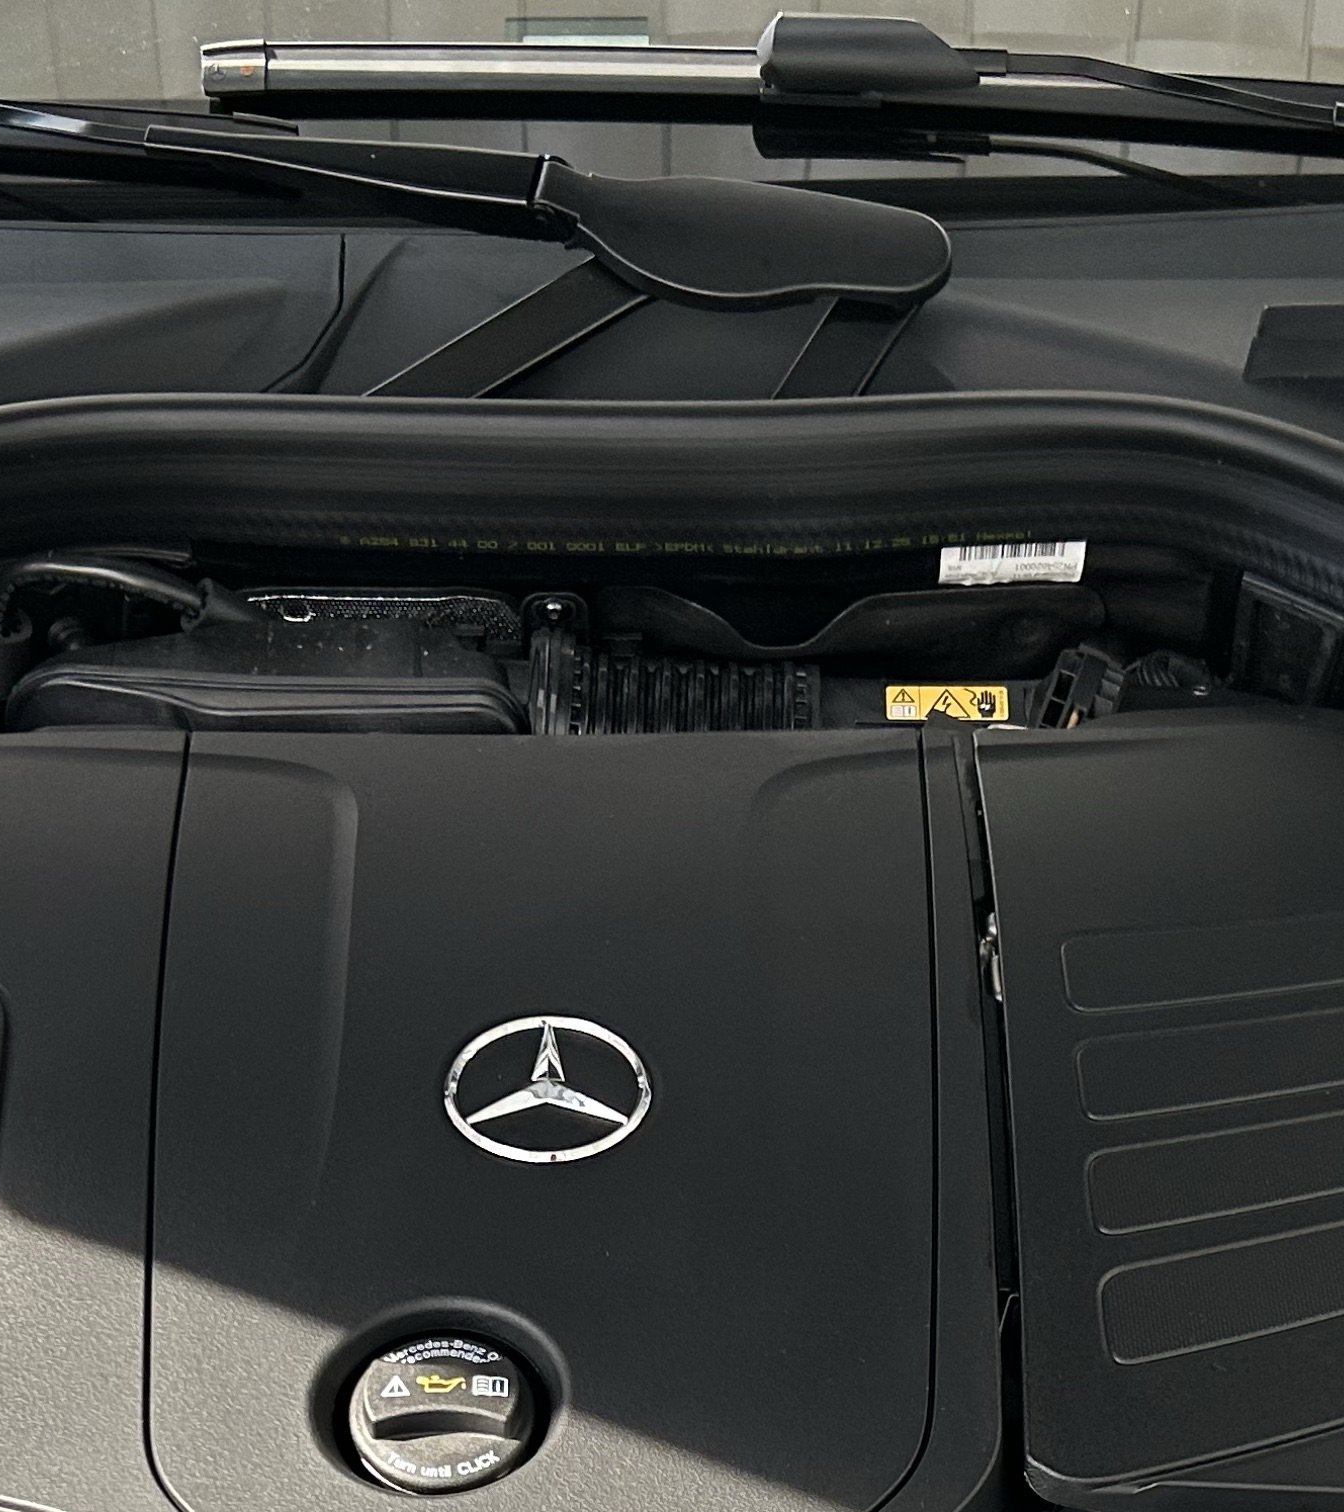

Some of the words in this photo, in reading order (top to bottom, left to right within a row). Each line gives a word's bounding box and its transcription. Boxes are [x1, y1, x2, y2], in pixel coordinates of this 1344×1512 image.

[387, 1451, 416, 1474] Turn
[420, 1464, 453, 1478] until
[456, 1449, 501, 1476] CLICK
